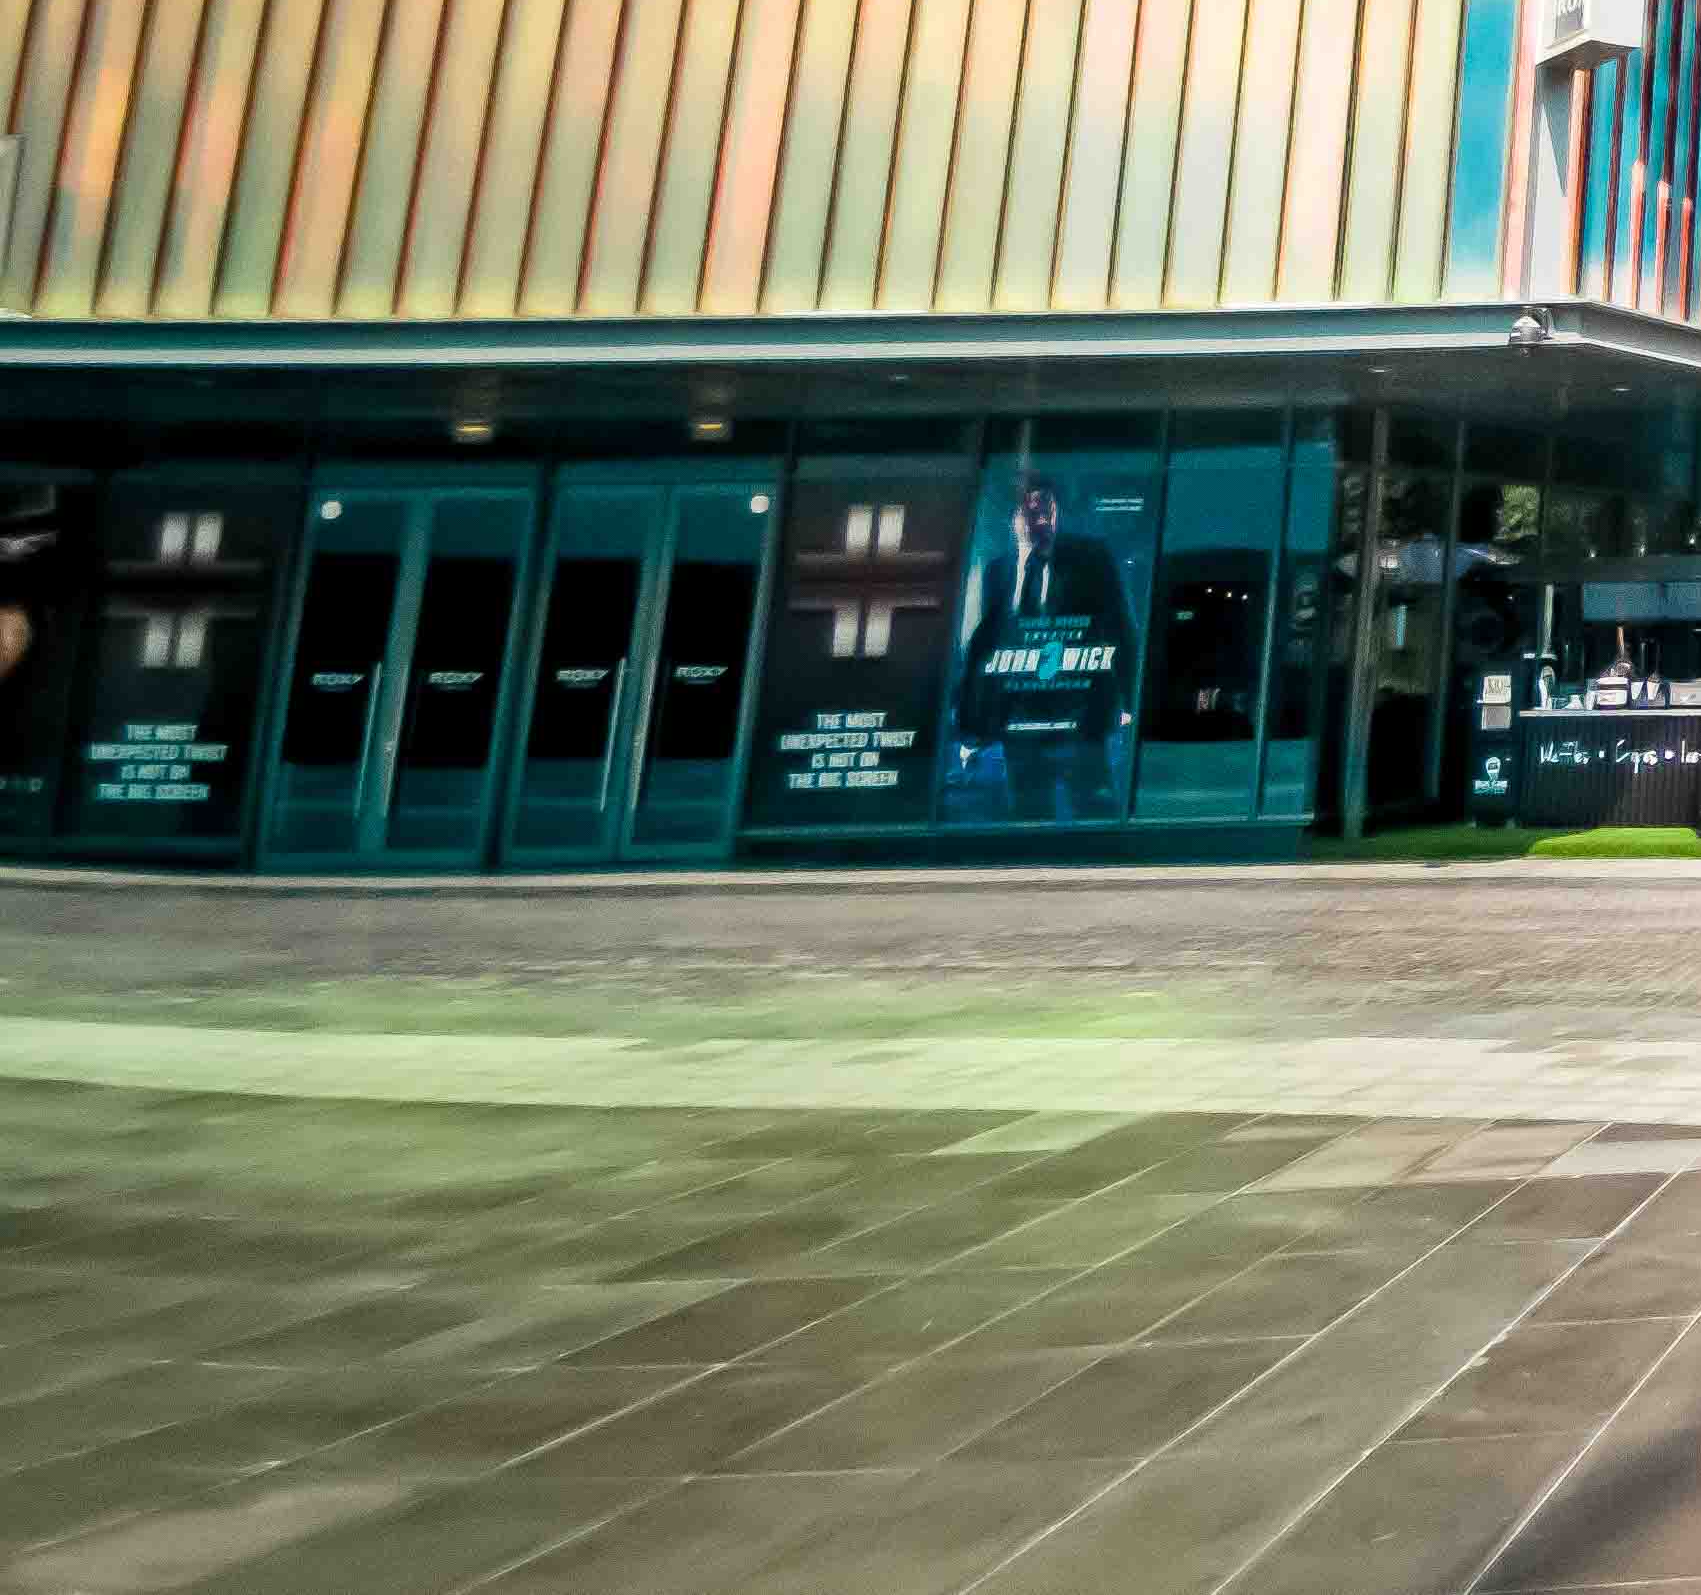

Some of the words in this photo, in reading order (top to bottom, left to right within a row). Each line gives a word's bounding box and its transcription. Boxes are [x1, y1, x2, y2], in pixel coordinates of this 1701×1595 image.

[984, 648, 1041, 674] JOHN
[1062, 646, 1116, 671] WICK
[428, 671, 485, 685] ROXY
[675, 666, 728, 678] ROXY
